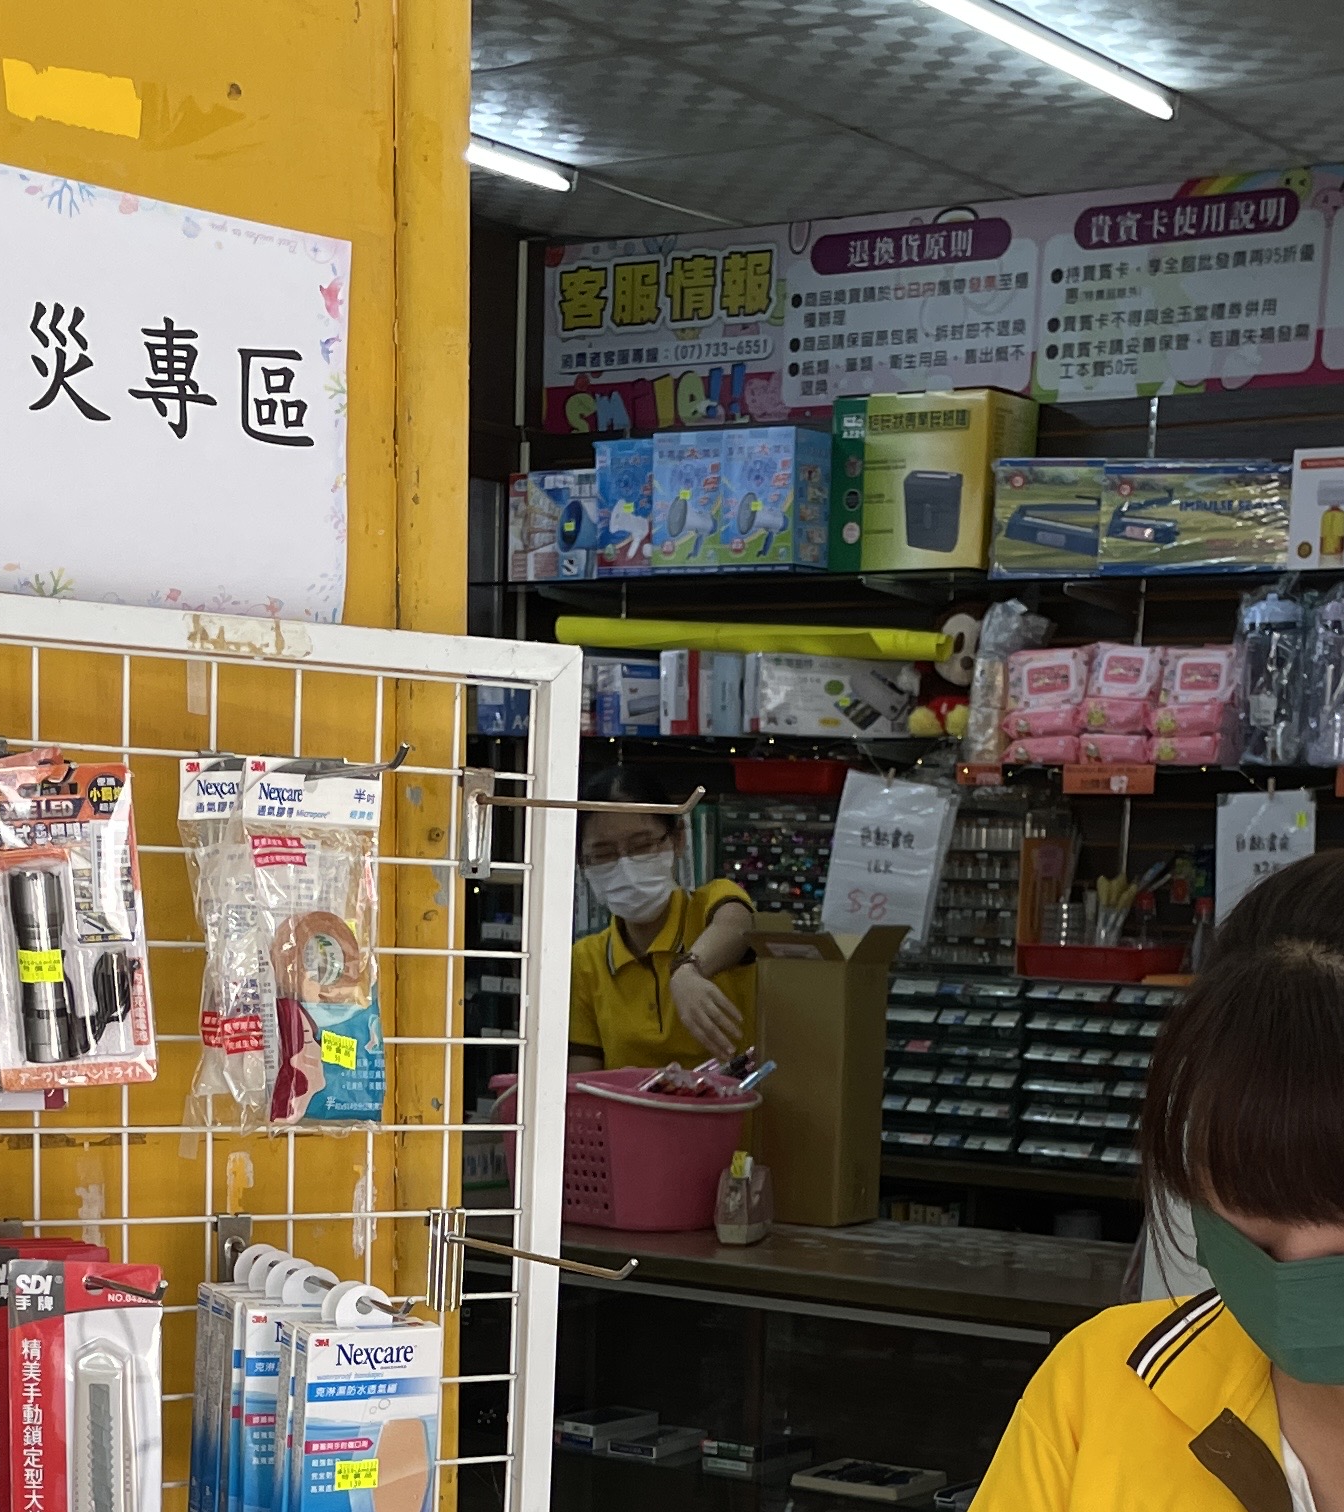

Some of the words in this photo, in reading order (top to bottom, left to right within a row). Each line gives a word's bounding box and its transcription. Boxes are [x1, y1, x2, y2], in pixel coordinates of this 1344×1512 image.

[1089, 196, 1286, 245] 貴賓卡使用說明
[847, 228, 974, 268] 退換貨原則
[559, 248, 773, 331] 客服情報
[250, 761, 266, 773] 3M
[258, 781, 304, 803] Nexcare
[16, 1275, 54, 1296] SDI
[15, 1295, 54, 1312] 手牌
[252, 1315, 268, 1324] 3M
[314, 1338, 330, 1348] 3M
[336, 1343, 414, 1370] Nexcare
